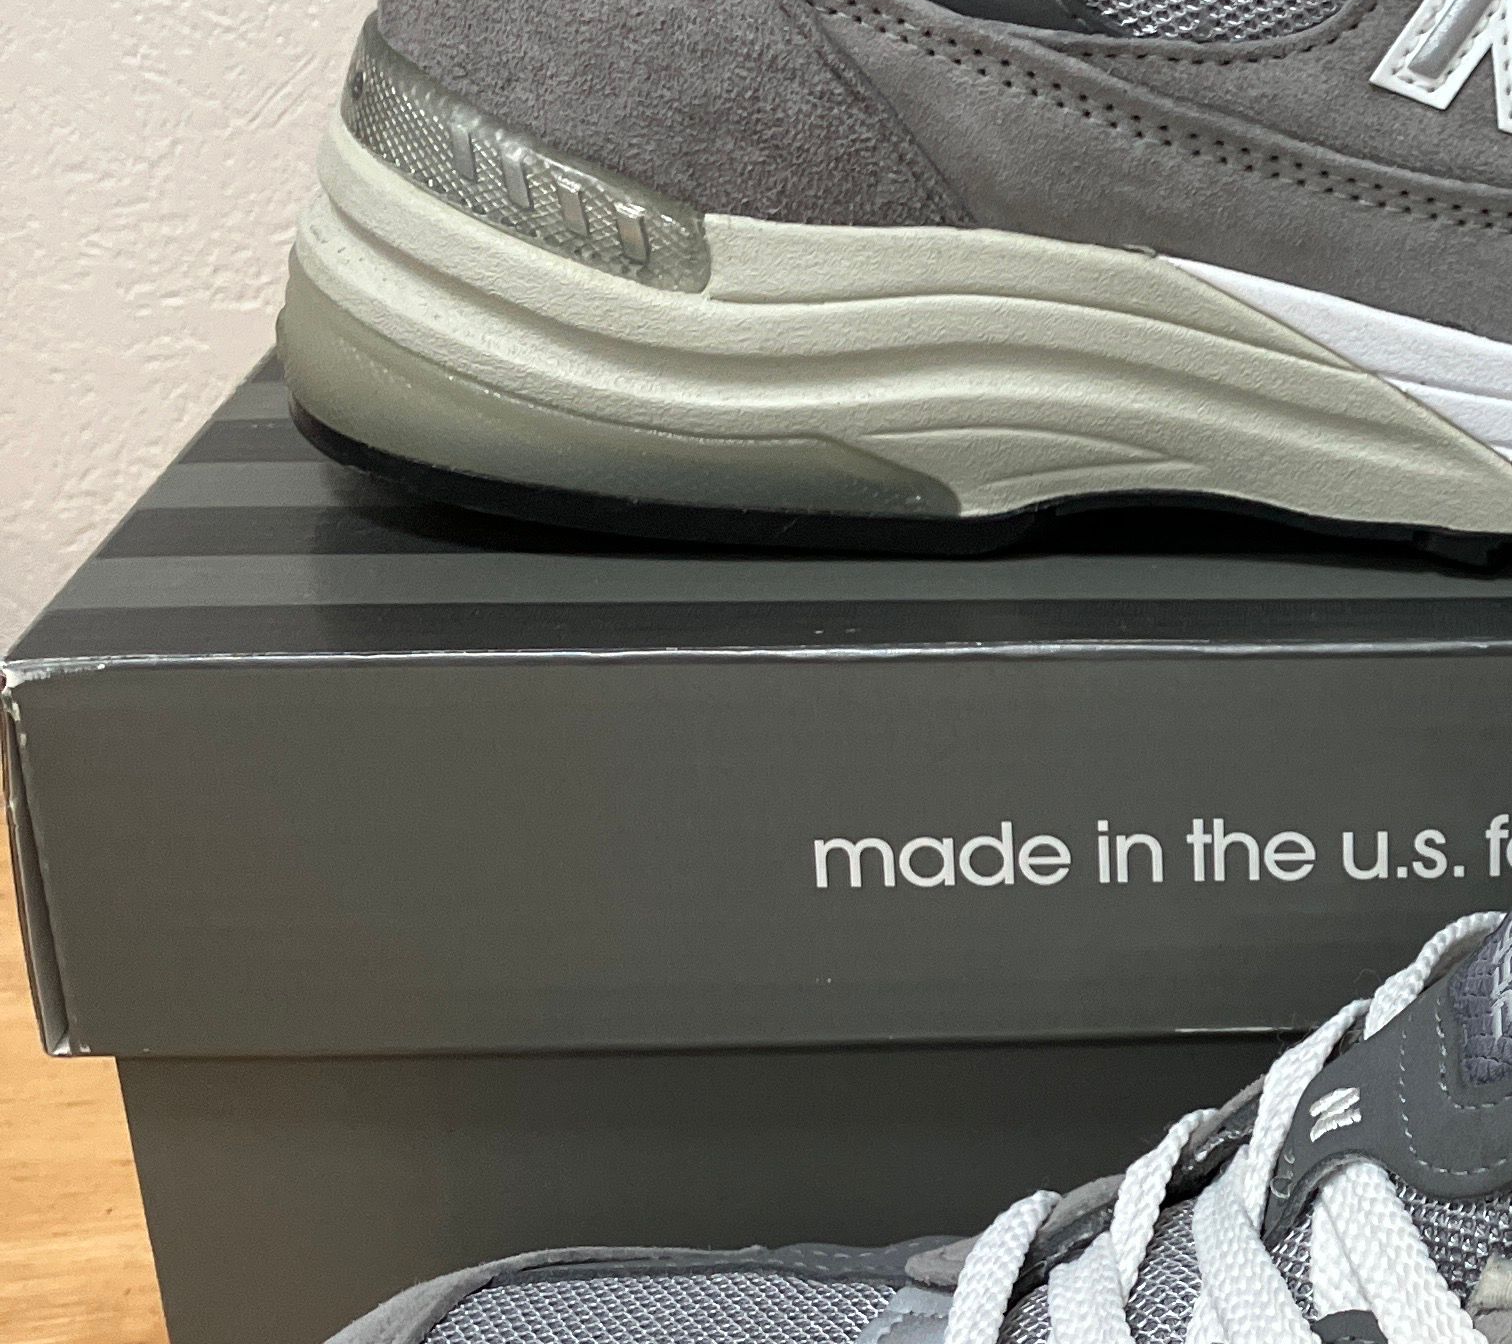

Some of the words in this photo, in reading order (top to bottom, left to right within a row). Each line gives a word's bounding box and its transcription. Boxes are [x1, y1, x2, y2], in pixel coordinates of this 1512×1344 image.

[813, 820, 1072, 889] made
[1097, 819, 1164, 884] in
[1185, 817, 1316, 882] the
[1342, 829, 1465, 880] u.s.
